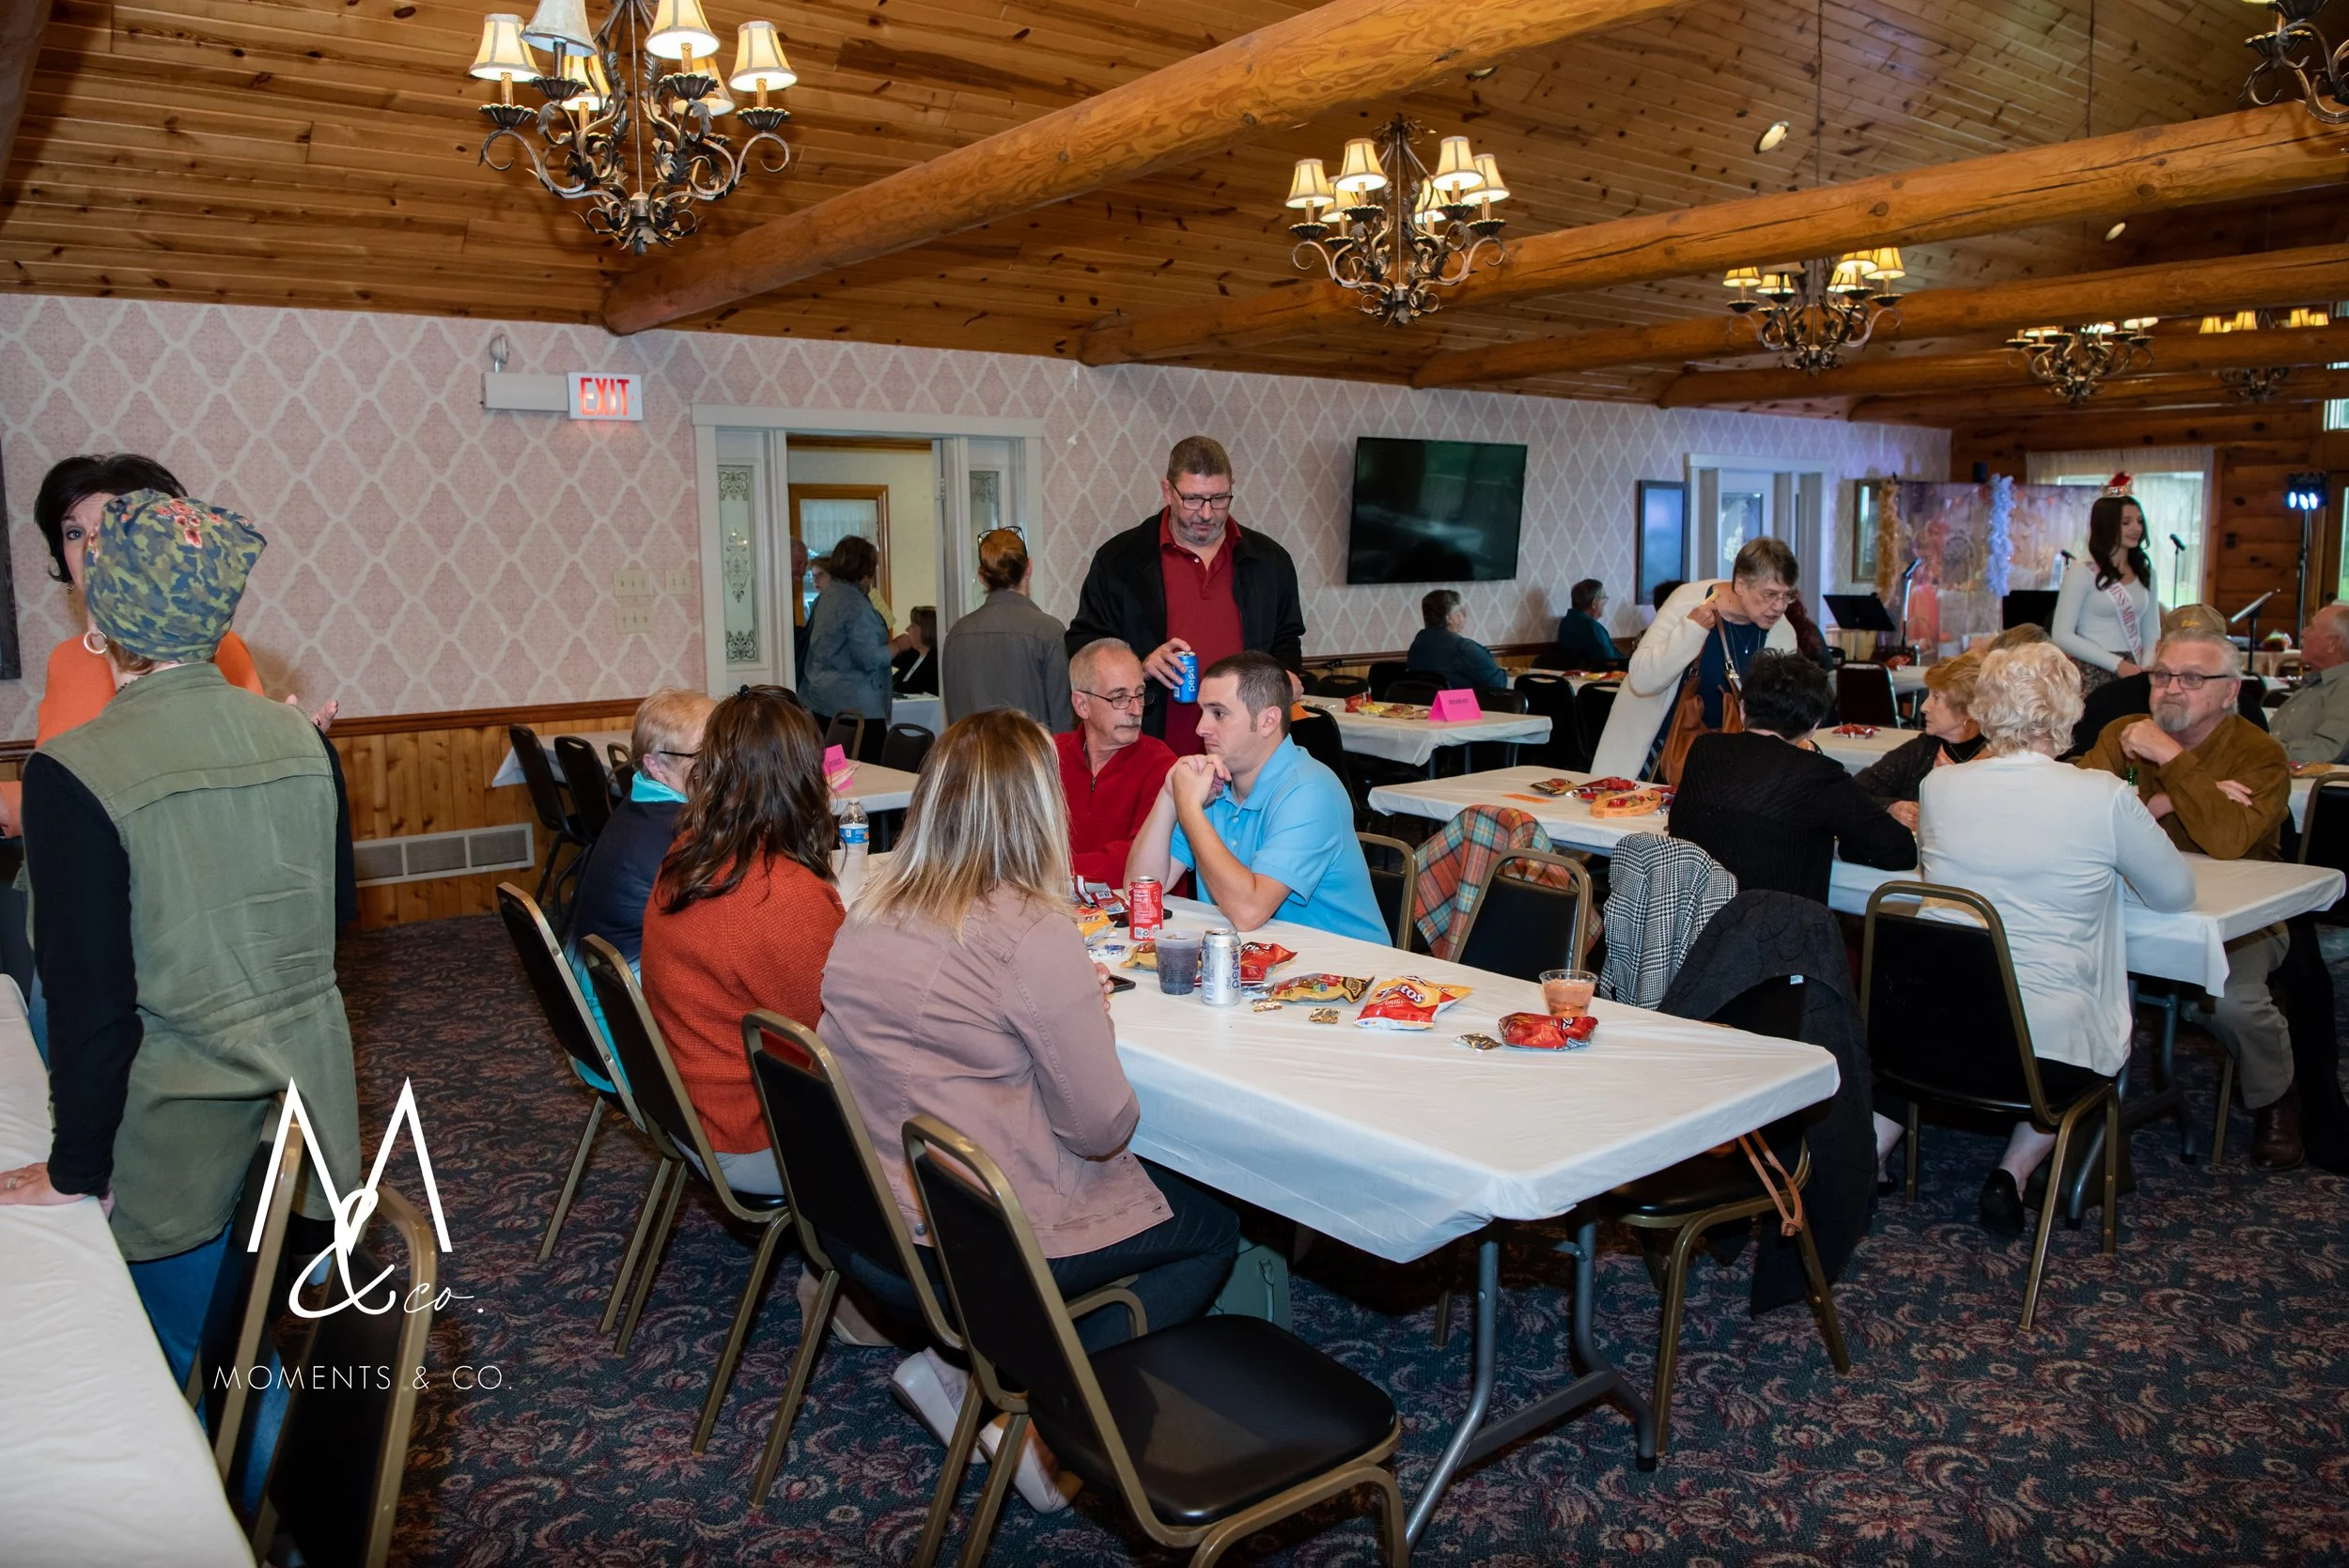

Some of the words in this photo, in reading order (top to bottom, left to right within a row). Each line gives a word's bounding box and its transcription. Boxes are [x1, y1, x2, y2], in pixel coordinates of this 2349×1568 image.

[580, 377, 630, 416] EXIT
[1187, 665, 1196, 692] pepsi
[1230, 950, 1240, 989] pepsi
